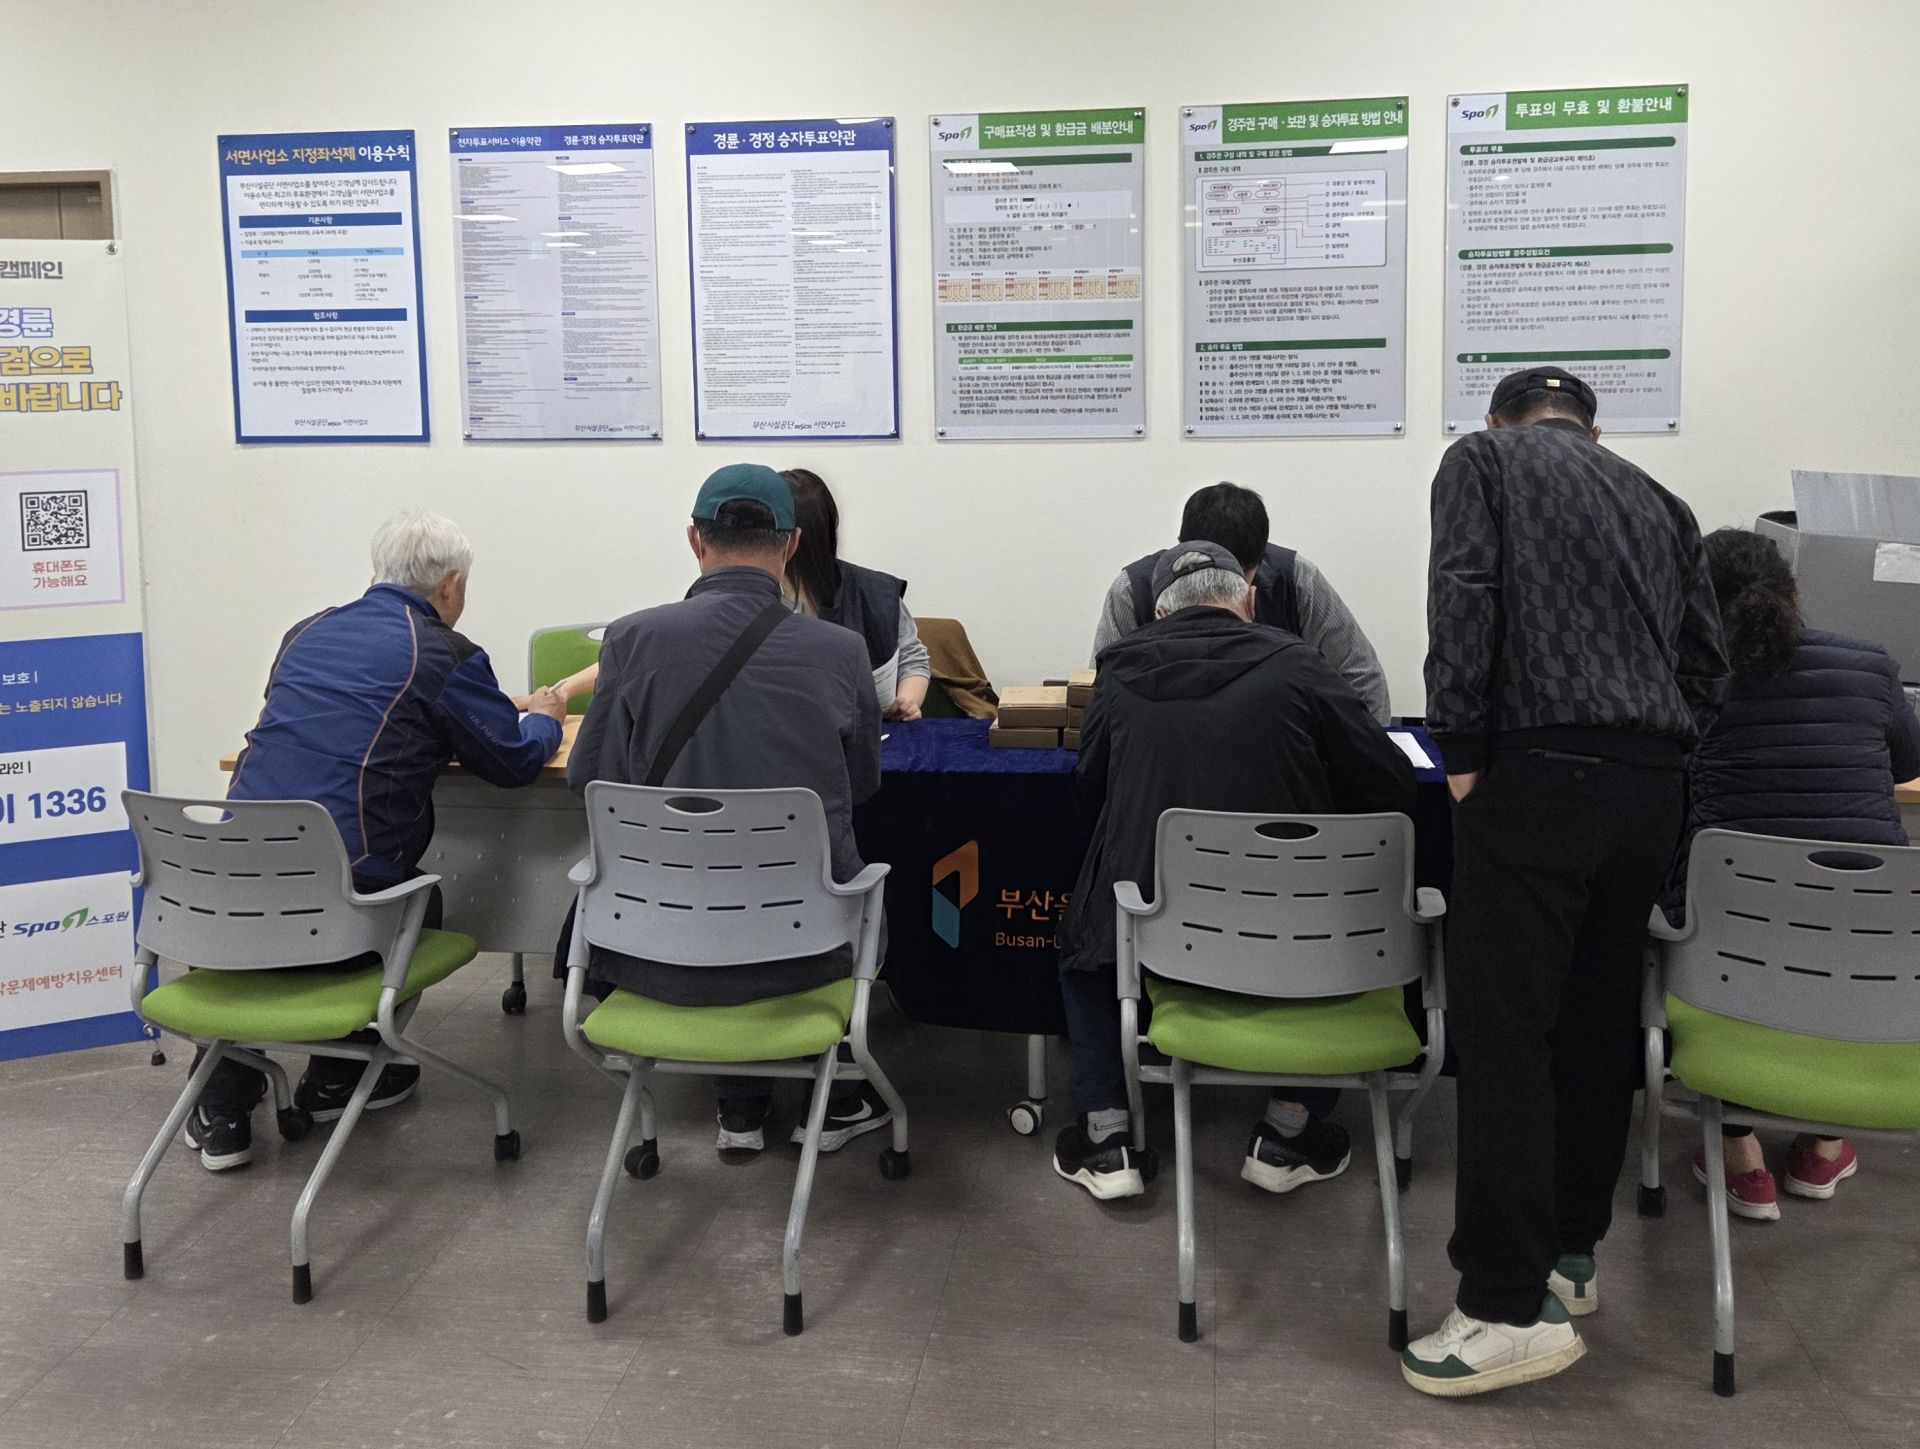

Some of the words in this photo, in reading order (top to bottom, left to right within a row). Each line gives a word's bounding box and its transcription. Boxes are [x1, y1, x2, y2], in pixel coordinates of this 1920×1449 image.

[1515, 102, 1555, 116] 투표의
[1562, 101, 1589, 114] 무효
[1597, 99, 1609, 113] 및
[1617, 97, 1671, 112] 환불안내
[984, 124, 1035, 137] 구매표작성
[1040, 124, 1050, 136] 및
[1055, 122, 1086, 135] 환급금
[1091, 121, 1132, 133] 배분안내
[1228, 118, 1254, 130] 경주권
[1258, 116, 1277, 129] 구매
[1287, 115, 1306, 127] 보관
[1309, 114, 1318, 127] 및
[1321, 113, 1358, 126] 승자투표
[1361, 112, 1380, 125] 방법
[1383, 110, 1402, 124] 안내
[456, 137, 509, 146] 전자투표서비스
[511, 136, 541, 146] 이용약관
[598, 134, 645, 144] 승자투표약관
[713, 133, 739, 148] 경륜
[749, 132, 774, 147] 경정
[777, 130, 855, 146] 승자투표약관
[226, 150, 288, 164] 서면사업소
[292, 147, 354, 162] 지정좌석제
[358, 145, 409, 161] 이용수칙
[308, 216, 332, 224] 기본사항
[0, 261, 63, 279] 캠페인
[0, 308, 54, 338] 경륜
[0, 346, 93, 376] 검으로
[0, 381, 122, 412] 바랍니다
[32, 560, 88, 574] 휴대폰도
[33, 575, 88, 589] 가능해요
[2, 672, 30, 685] 보호
[15, 698, 67, 713] 노출되지
[71, 692, 122, 709] 않습니다
[28, 786, 107, 819] 1336
[85, 910, 130, 926] 스포원
